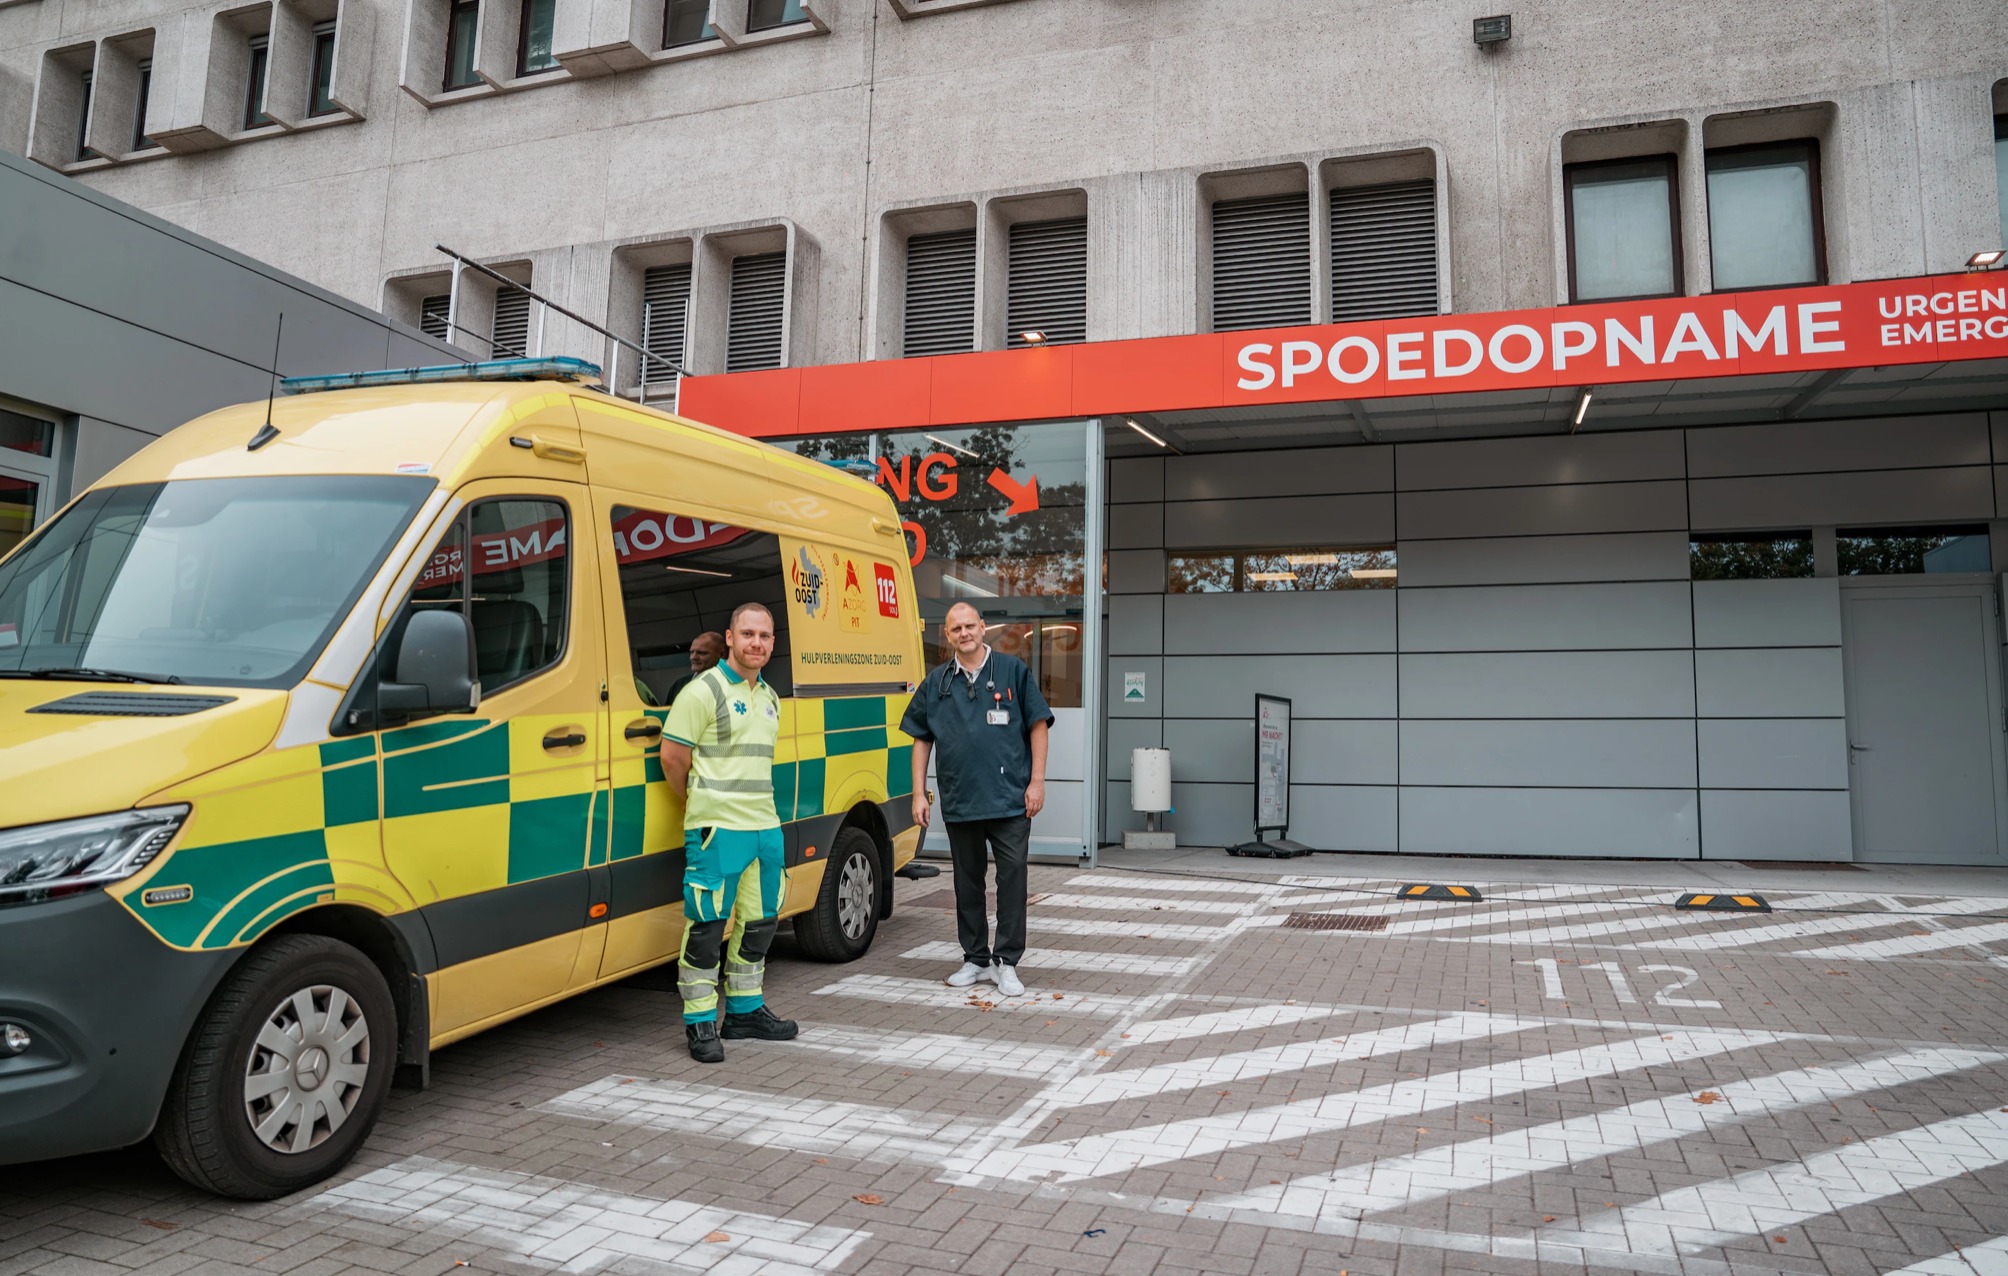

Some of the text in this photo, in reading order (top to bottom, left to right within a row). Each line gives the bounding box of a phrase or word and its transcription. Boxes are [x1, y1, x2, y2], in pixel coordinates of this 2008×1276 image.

[1878, 288, 2006, 318] URGEN
[1881, 315, 2008, 347] EMERG
[1236, 300, 1846, 391] SPOEDOPNAME
[800, 572, 823, 589] ZUID-
[877, 577, 896, 604] 112
[795, 588, 817, 605] OOST
[851, 617, 860, 628] PIT
[801, 652, 902, 666] HULPVERLENINGSZONE ZUID-OOST
[1516, 958, 1722, 1009] 112
